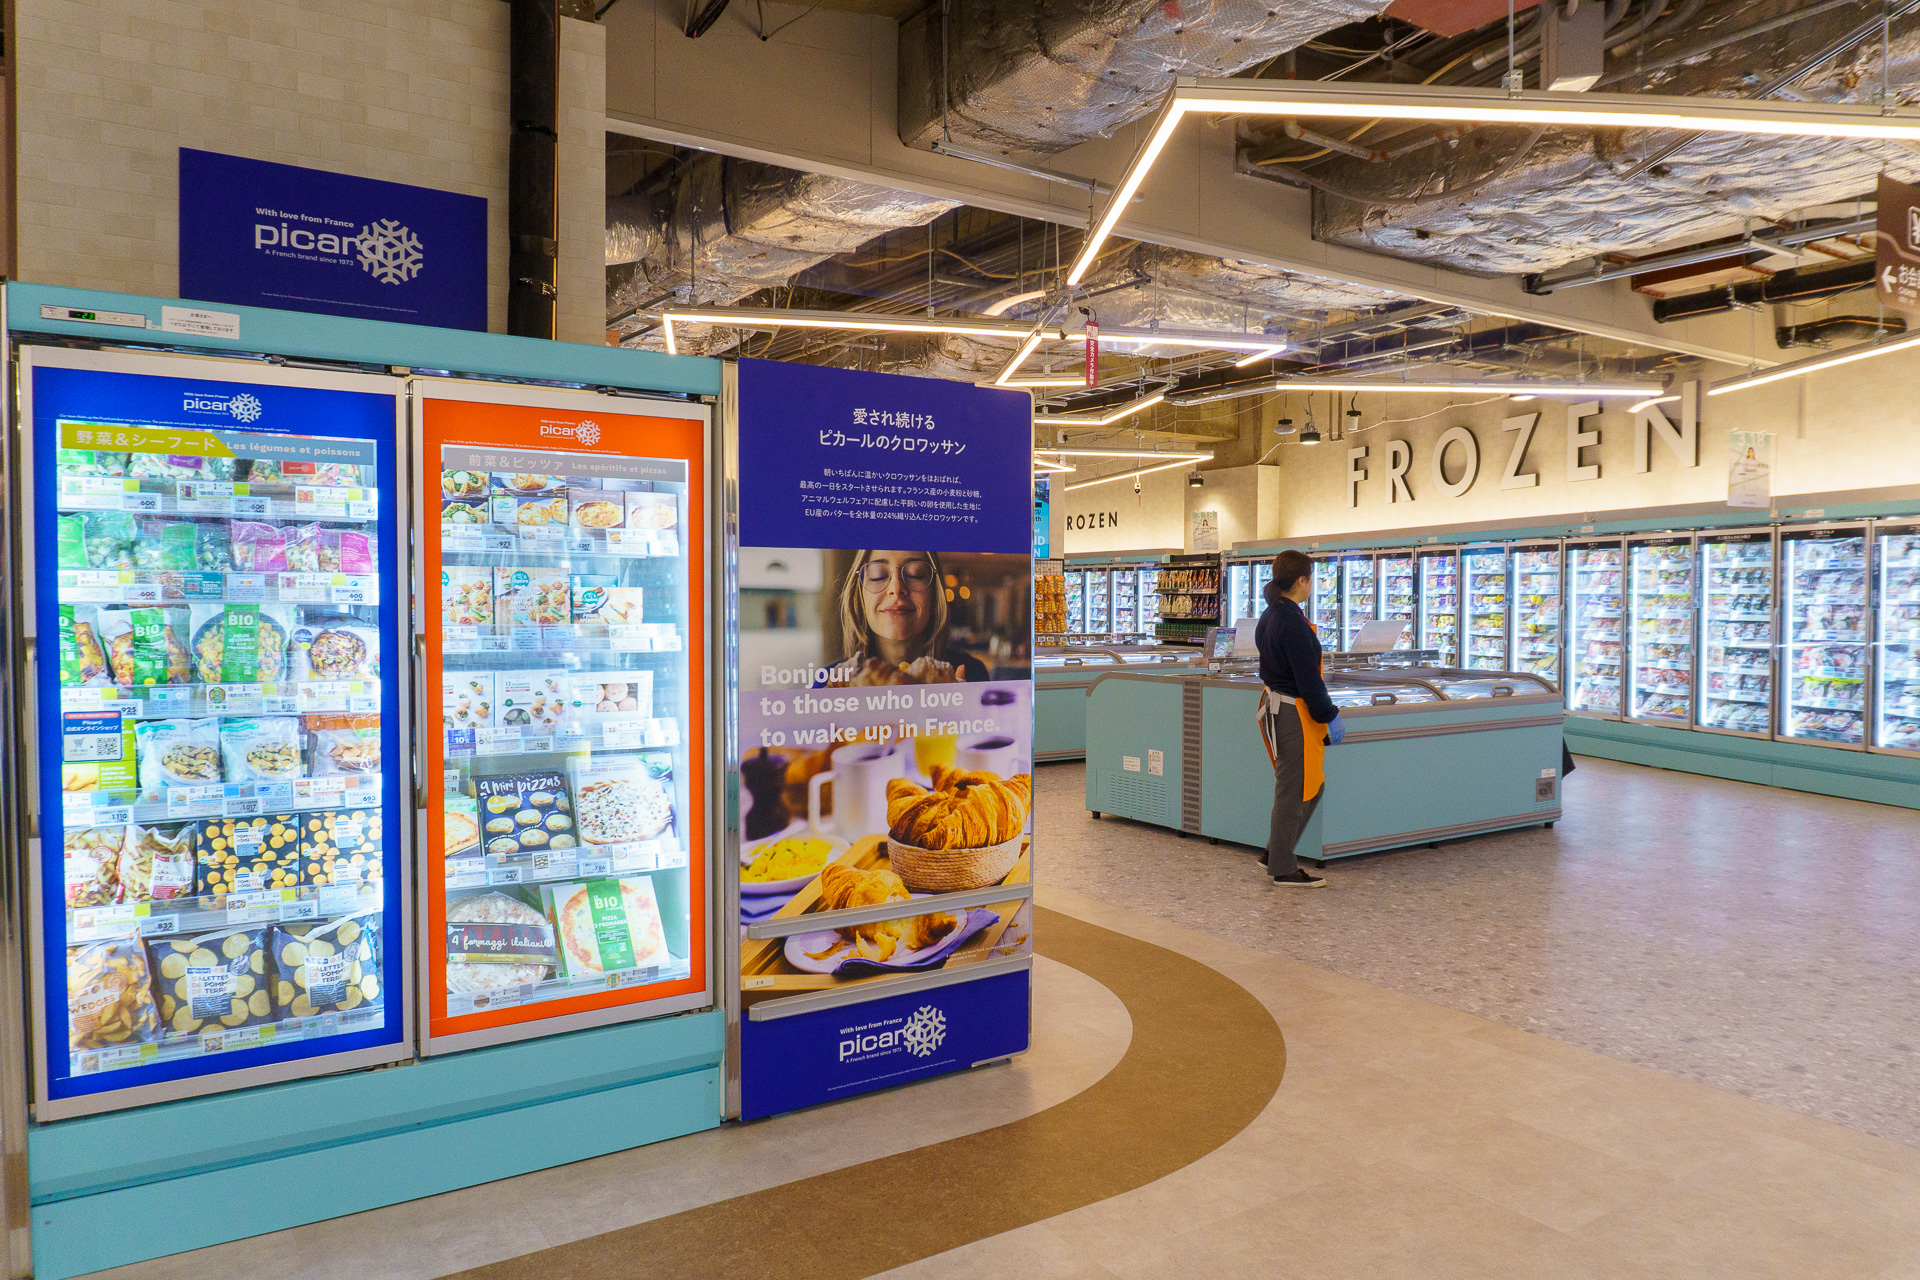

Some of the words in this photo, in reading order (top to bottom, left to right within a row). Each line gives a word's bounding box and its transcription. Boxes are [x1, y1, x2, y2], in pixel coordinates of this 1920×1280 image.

[255, 207, 278, 217] With
[280, 210, 299, 220] love
[300, 213, 322, 224] from
[324, 217, 355, 228] France
[255, 222, 385, 260] picard
[272, 249, 297, 259] French
[298, 252, 318, 262] brand
[319, 256, 337, 264] since
[338, 258, 354, 266] 1973
[852, 407, 936, 430] 愛され続ける
[75, 430, 216, 452] 野菜&シーフード
[226, 440, 247, 451] Les
[249, 441, 297, 456] légumes
[298, 444, 312, 455] et
[313, 445, 362, 458] poissons
[818, 428, 967, 456] ピカールのクロワッサン
[1347, 380, 1700, 508] FROZEN
[468, 453, 564, 470] 前菜&ピッツァ
[571, 461, 588, 471] Les
[589, 461, 627, 474] apéritifs
[629, 464, 639, 473] et
[641, 466, 668, 476] pizzas
[823, 468, 963, 485] 朝いちばんに温かいクロワッサンをほおばれば、
[1066, 511, 1118, 531] ROZEN
[228, 614, 254, 626] BIO
[134, 624, 160, 637] BIO
[760, 662, 854, 690] Bonjour
[760, 696, 786, 717] to
[792, 693, 860, 715] those
[865, 690, 914, 711] who
[920, 688, 964, 708] love
[760, 727, 786, 748] to
[792, 723, 858, 746] wake
[864, 724, 892, 746] up
[899, 719, 918, 739] in
[925, 716, 1001, 737] France.
[491, 780, 514, 796] mini
[517, 774, 561, 800] pizzas
[594, 896, 618, 910] BIO
[451, 937, 460, 946] 4
[463, 936, 508, 952] formaggi
[510, 935, 546, 949] italiani
[69, 994, 116, 1015] WEDGES
[839, 1027, 855, 1035] With
[855, 1024, 868, 1032] love
[868, 1021, 883, 1029] from
[883, 1017, 903, 1027] France
[839, 1021, 921, 1062] picard
[850, 1055, 866, 1063] French
[866, 1052, 880, 1060] brand
